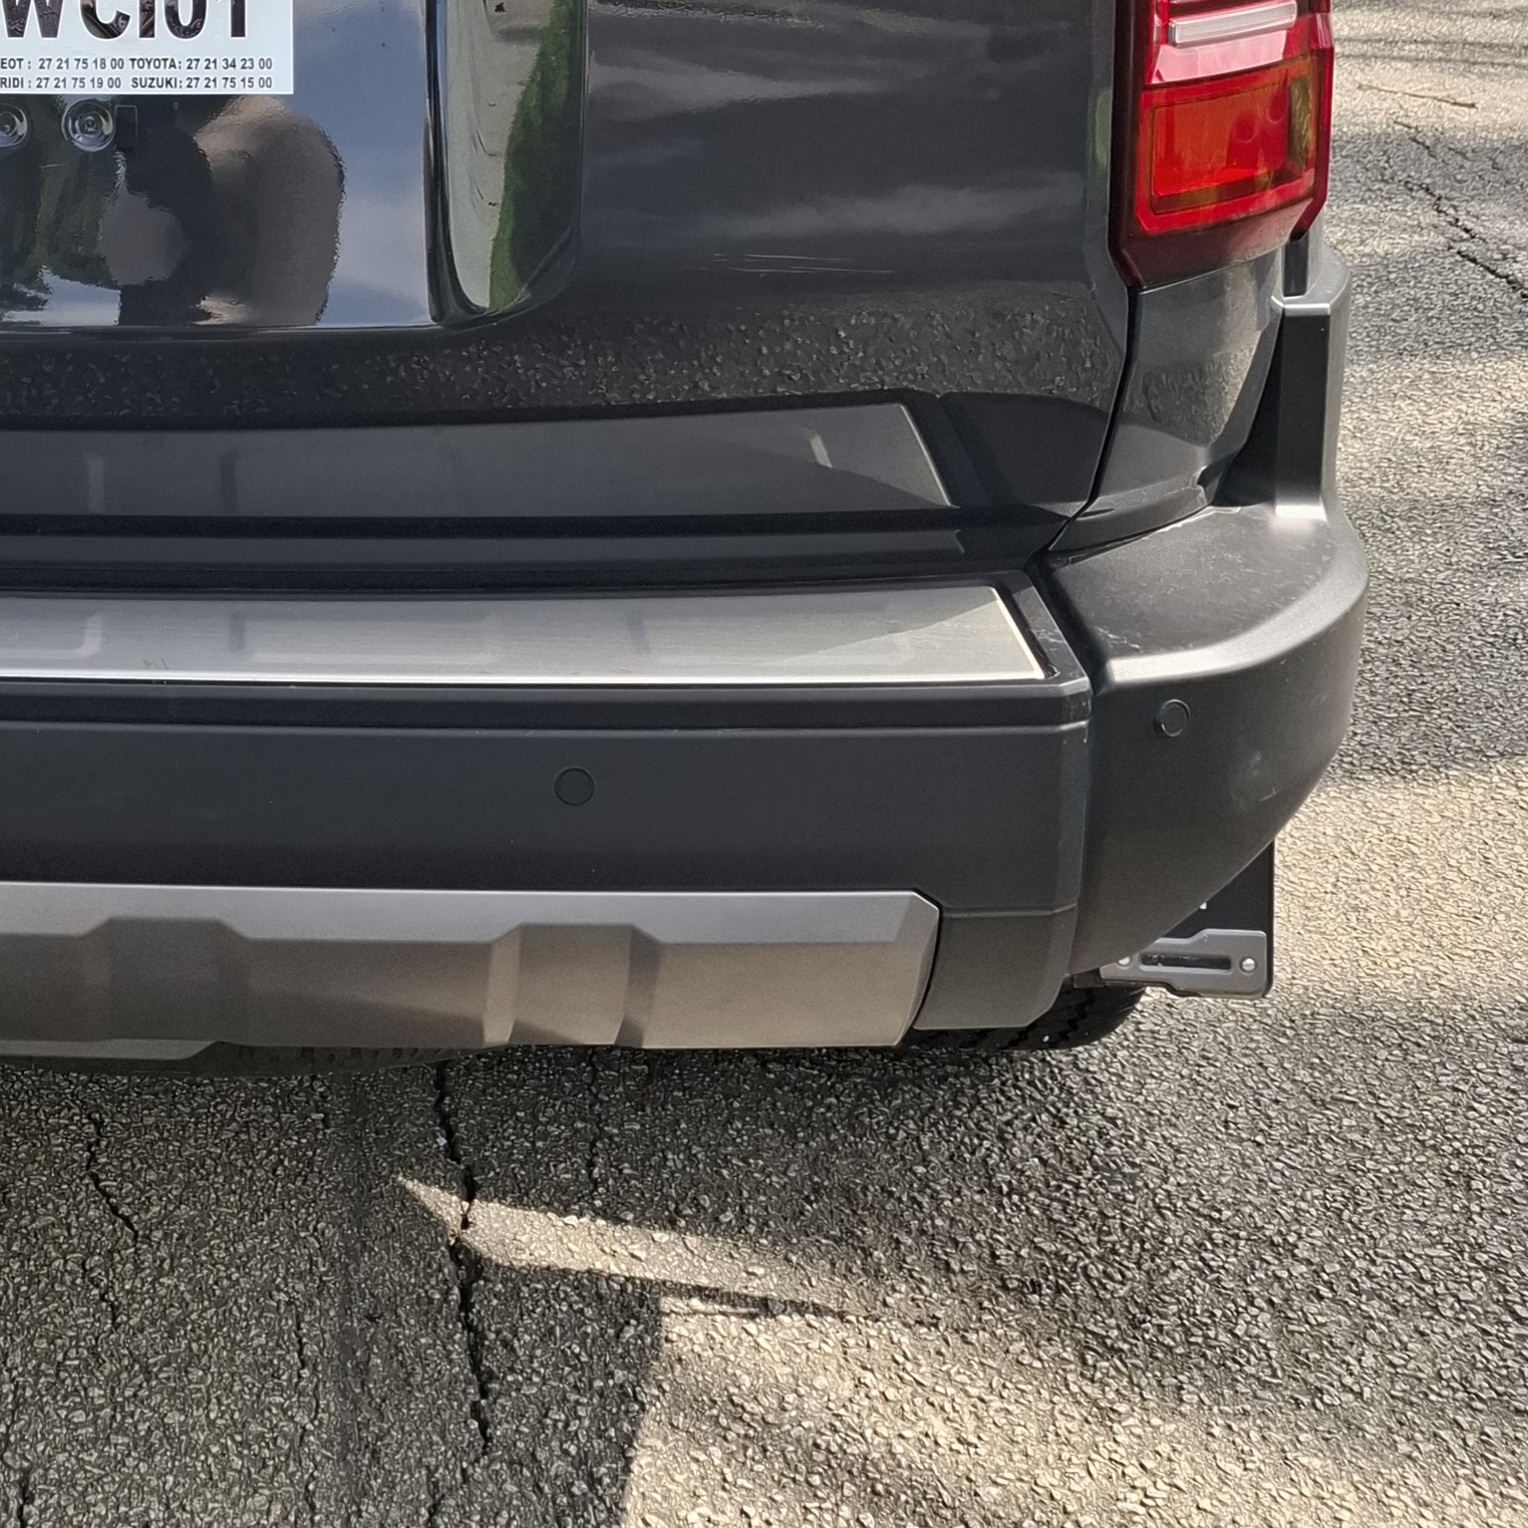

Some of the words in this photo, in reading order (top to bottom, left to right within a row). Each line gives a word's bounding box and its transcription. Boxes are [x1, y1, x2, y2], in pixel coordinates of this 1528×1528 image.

[38, 57, 53, 70] 27
[56, 57, 70, 70] 21
[74, 57, 89, 70] 75
[92, 57, 107, 70] 18
[110, 57, 125, 70] 00
[186, 57, 201, 70] 27
[204, 57, 218, 70] 21
[222, 57, 237, 70] 34
[240, 57, 255, 70] 23
[258, 57, 273, 70] 00
[35, 76, 50, 89] 27
[53, 76, 67, 89] 21
[71, 76, 86, 89] 75
[89, 76, 104, 89] 19
[107, 76, 122, 89] 00
[186, 76, 201, 89] 27
[204, 76, 217, 89] 21
[221, 76, 237, 89] 75
[240, 76, 255, 89] 15
[258, 76, 273, 89] 00
